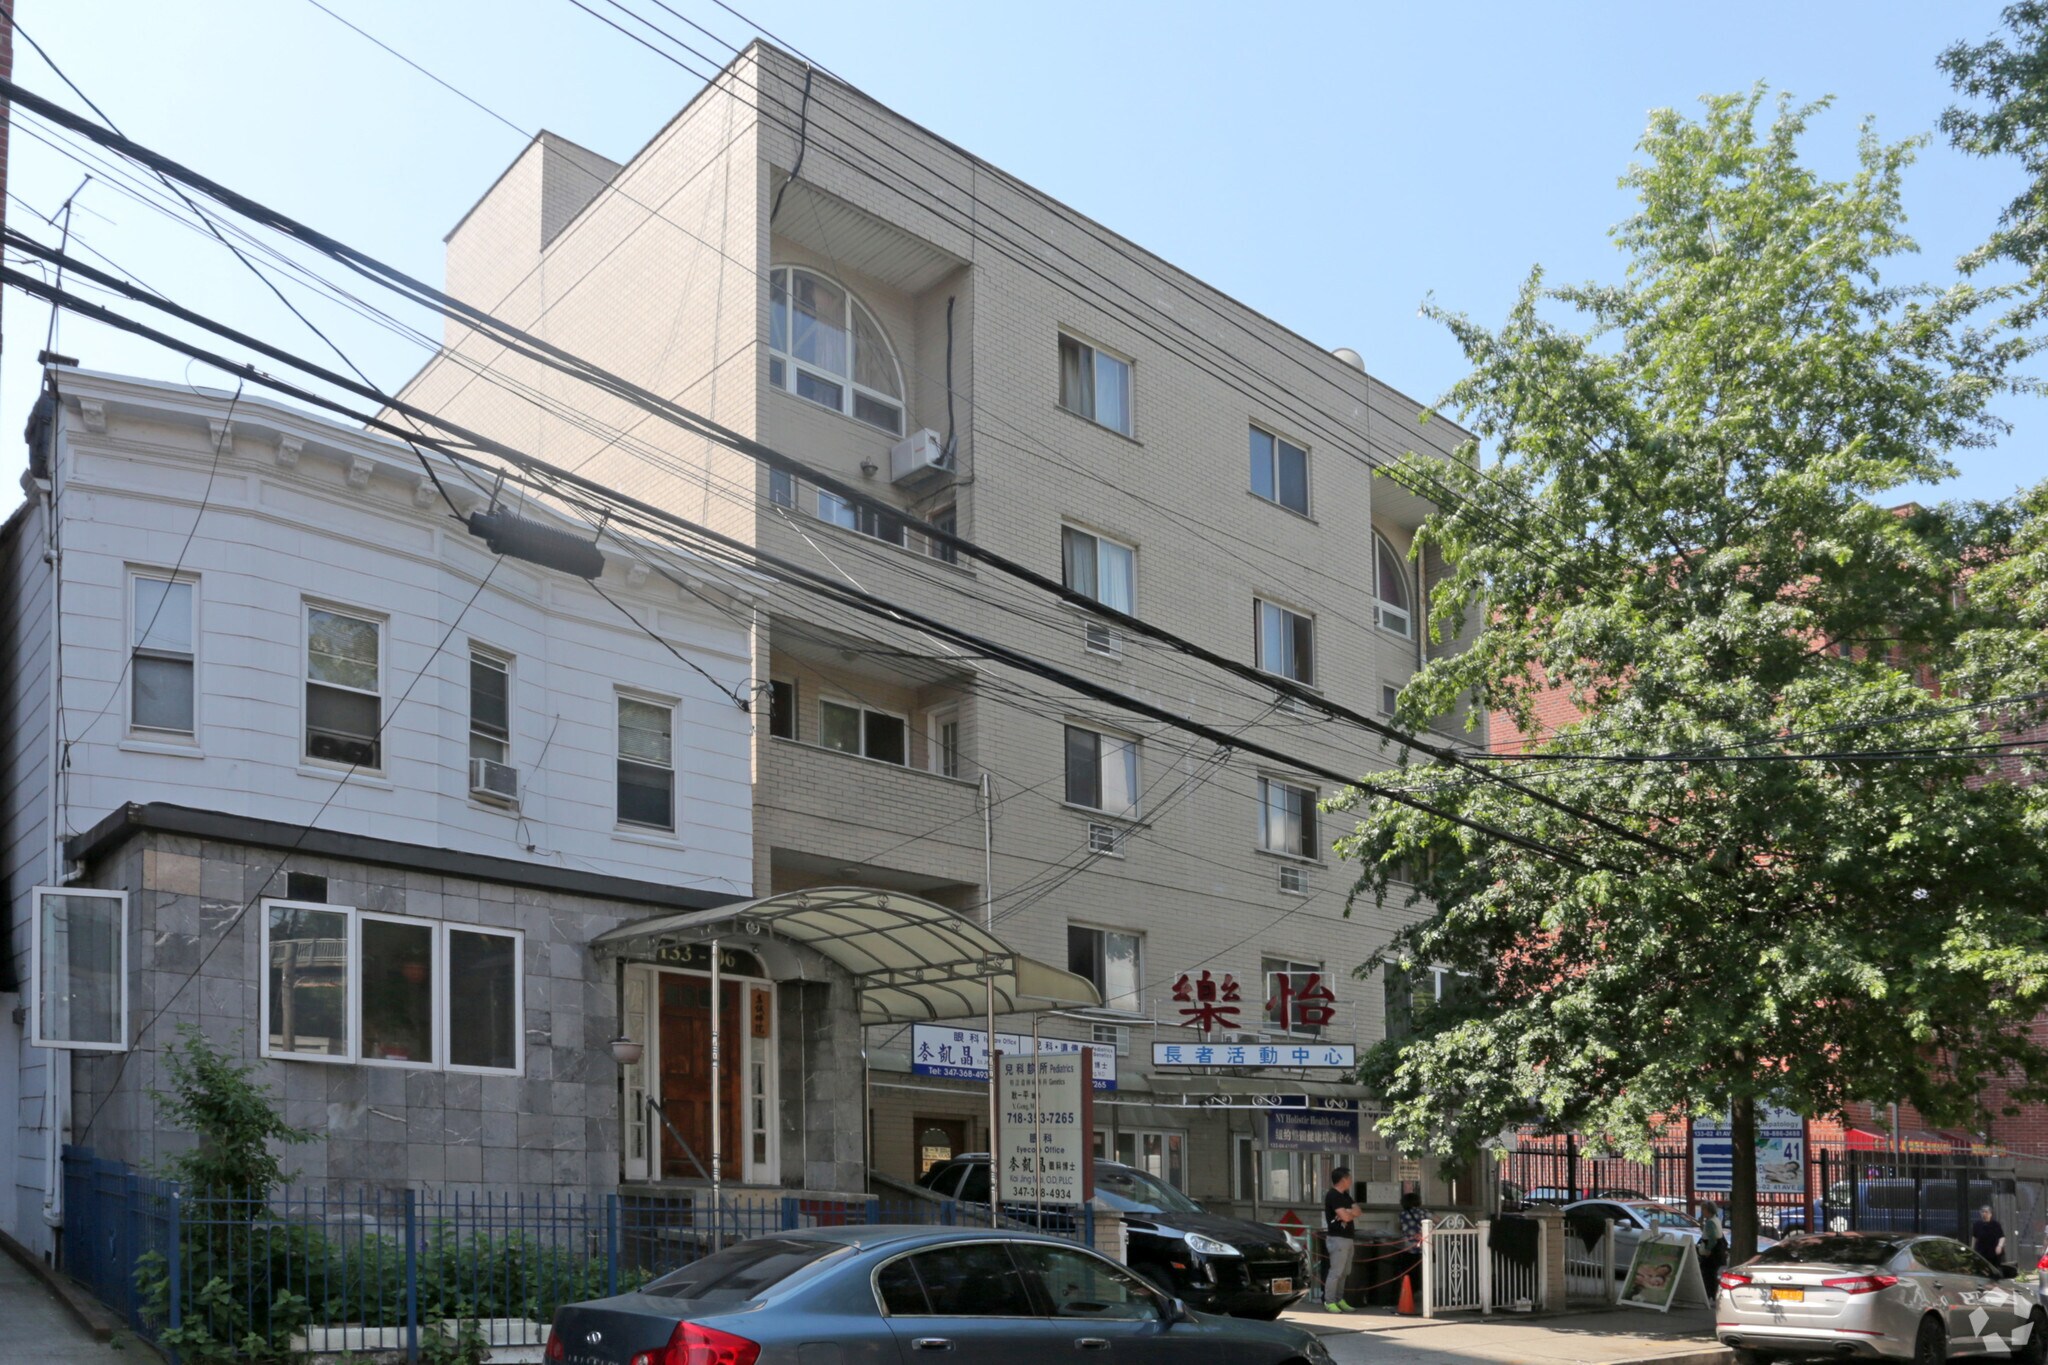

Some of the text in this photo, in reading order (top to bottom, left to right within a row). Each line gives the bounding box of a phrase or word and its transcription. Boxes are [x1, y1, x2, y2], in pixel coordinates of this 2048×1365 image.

[953, 1031, 980, 1045] 眼科
[1164, 1046, 1343, 1065] 長者活動中心
[928, 1066, 989, 1080] Tel: 347-368-493
[1050, 1064, 1074, 1074] Pediatrics
[1286, 1114, 1309, 1125] Holistic
[1310, 1116, 1329, 1126] Health
[1330, 1117, 1350, 1128] Center
[1044, 1146, 1065, 1154] Office
[1783, 1142, 1800, 1161] 41
